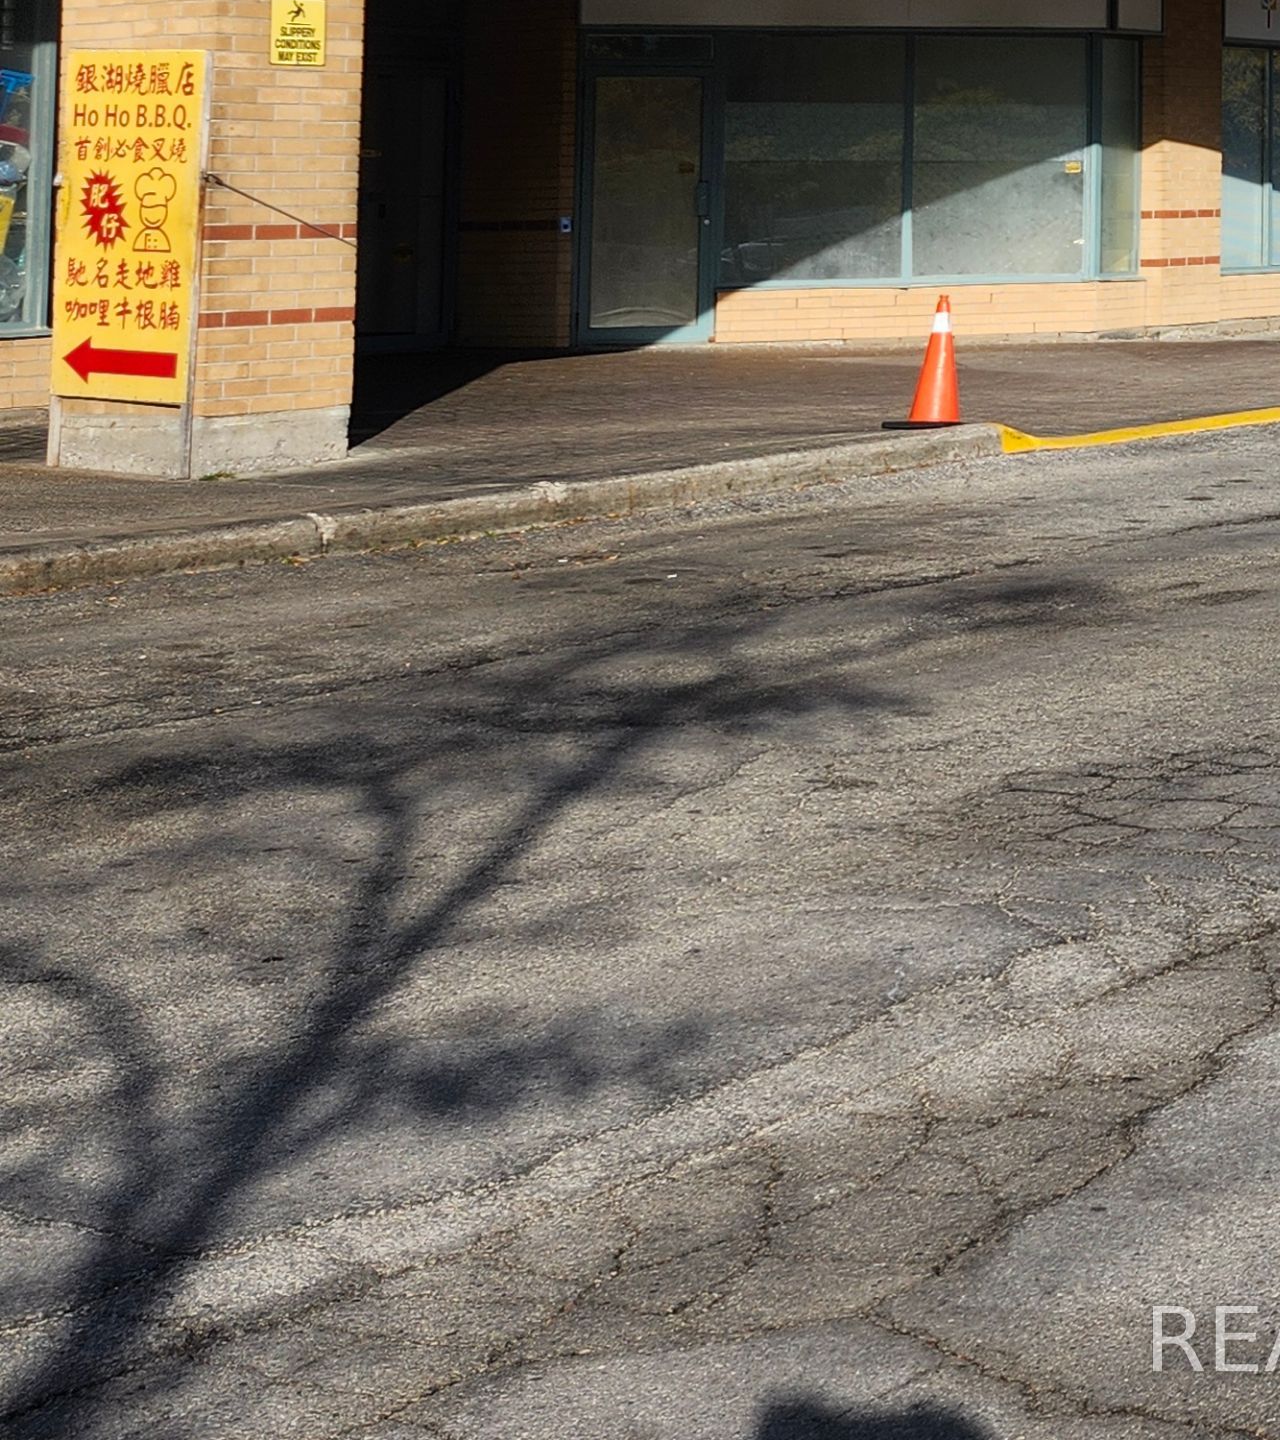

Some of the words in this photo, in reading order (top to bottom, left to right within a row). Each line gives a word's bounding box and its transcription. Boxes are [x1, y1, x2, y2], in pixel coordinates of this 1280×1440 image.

[280, 26, 316, 38] SLIPPERY
[275, 39, 321, 50] CONDITIONS
[278, 51, 294, 61] MAY
[296, 52, 318, 63] EXIST
[75, 62, 195, 96] 銀湖燒臘店
[135, 103, 192, 130] B.B.Q.
